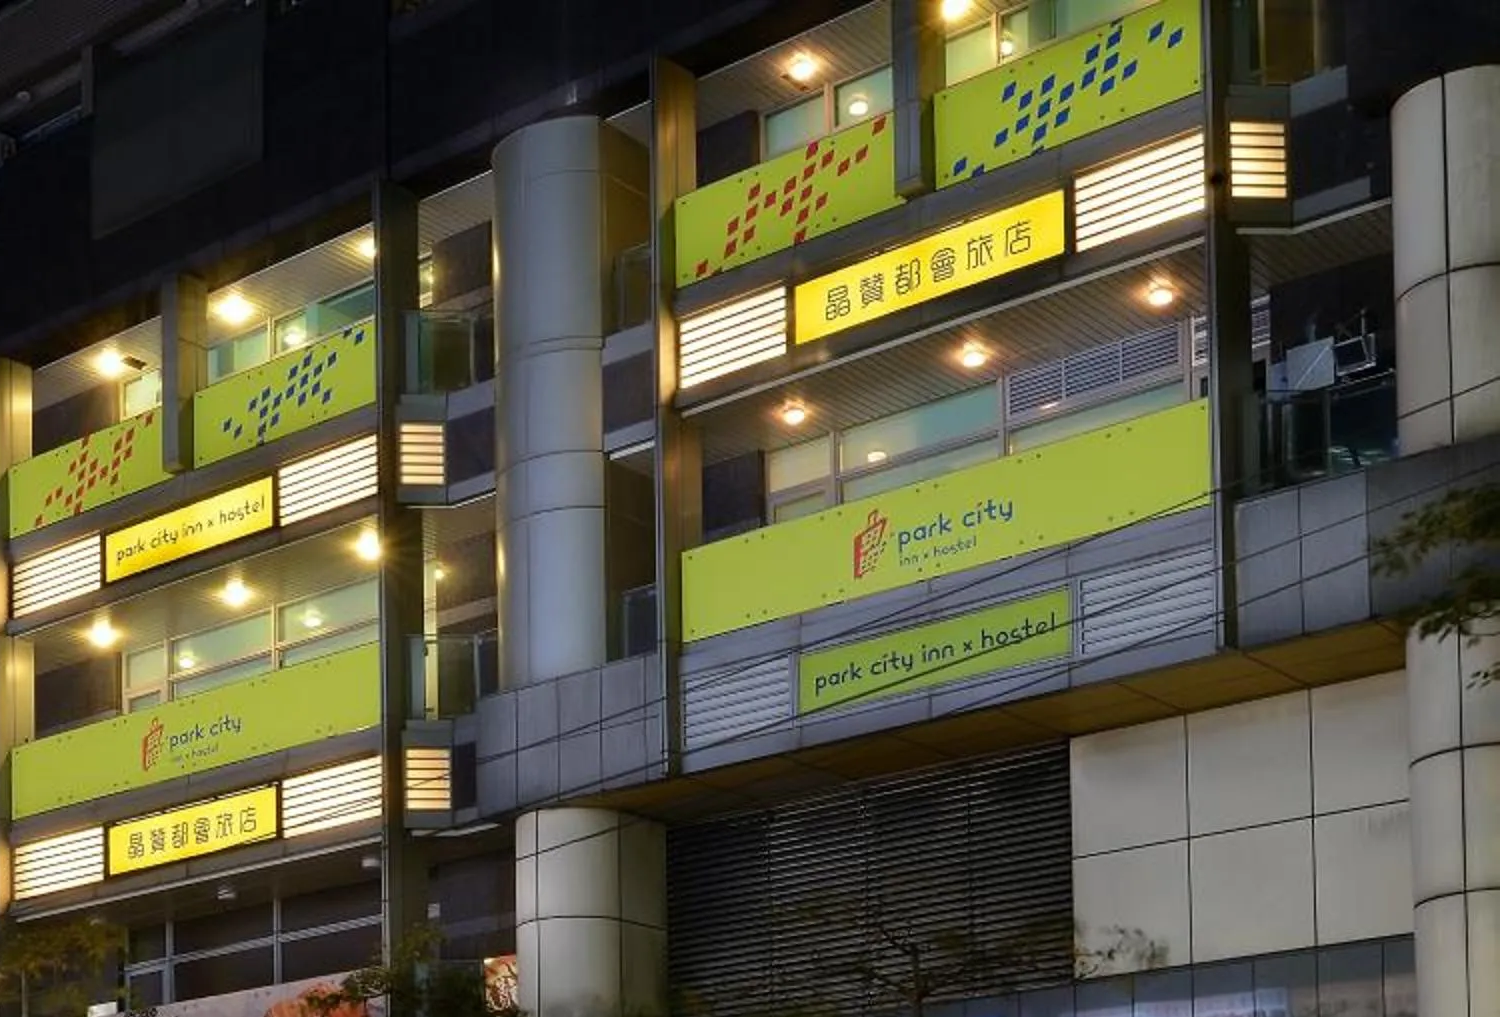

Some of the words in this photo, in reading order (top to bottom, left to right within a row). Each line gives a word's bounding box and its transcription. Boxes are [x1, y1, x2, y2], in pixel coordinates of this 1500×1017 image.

[116, 537, 147, 565] park
[150, 528, 179, 549] city
[182, 520, 203, 537] inn
[219, 495, 265, 526] hostel
[898, 513, 953, 553] park
[962, 499, 1014, 528] city
[900, 553, 919, 567] inn
[933, 535, 977, 557] hostel
[815, 662, 863, 696] park
[870, 652, 914, 676] city
[921, 644, 955, 664] inn
[963, 640, 973, 652] x
[981, 611, 1057, 649] hostel
[169, 723, 205, 751] park
[209, 712, 242, 736] city
